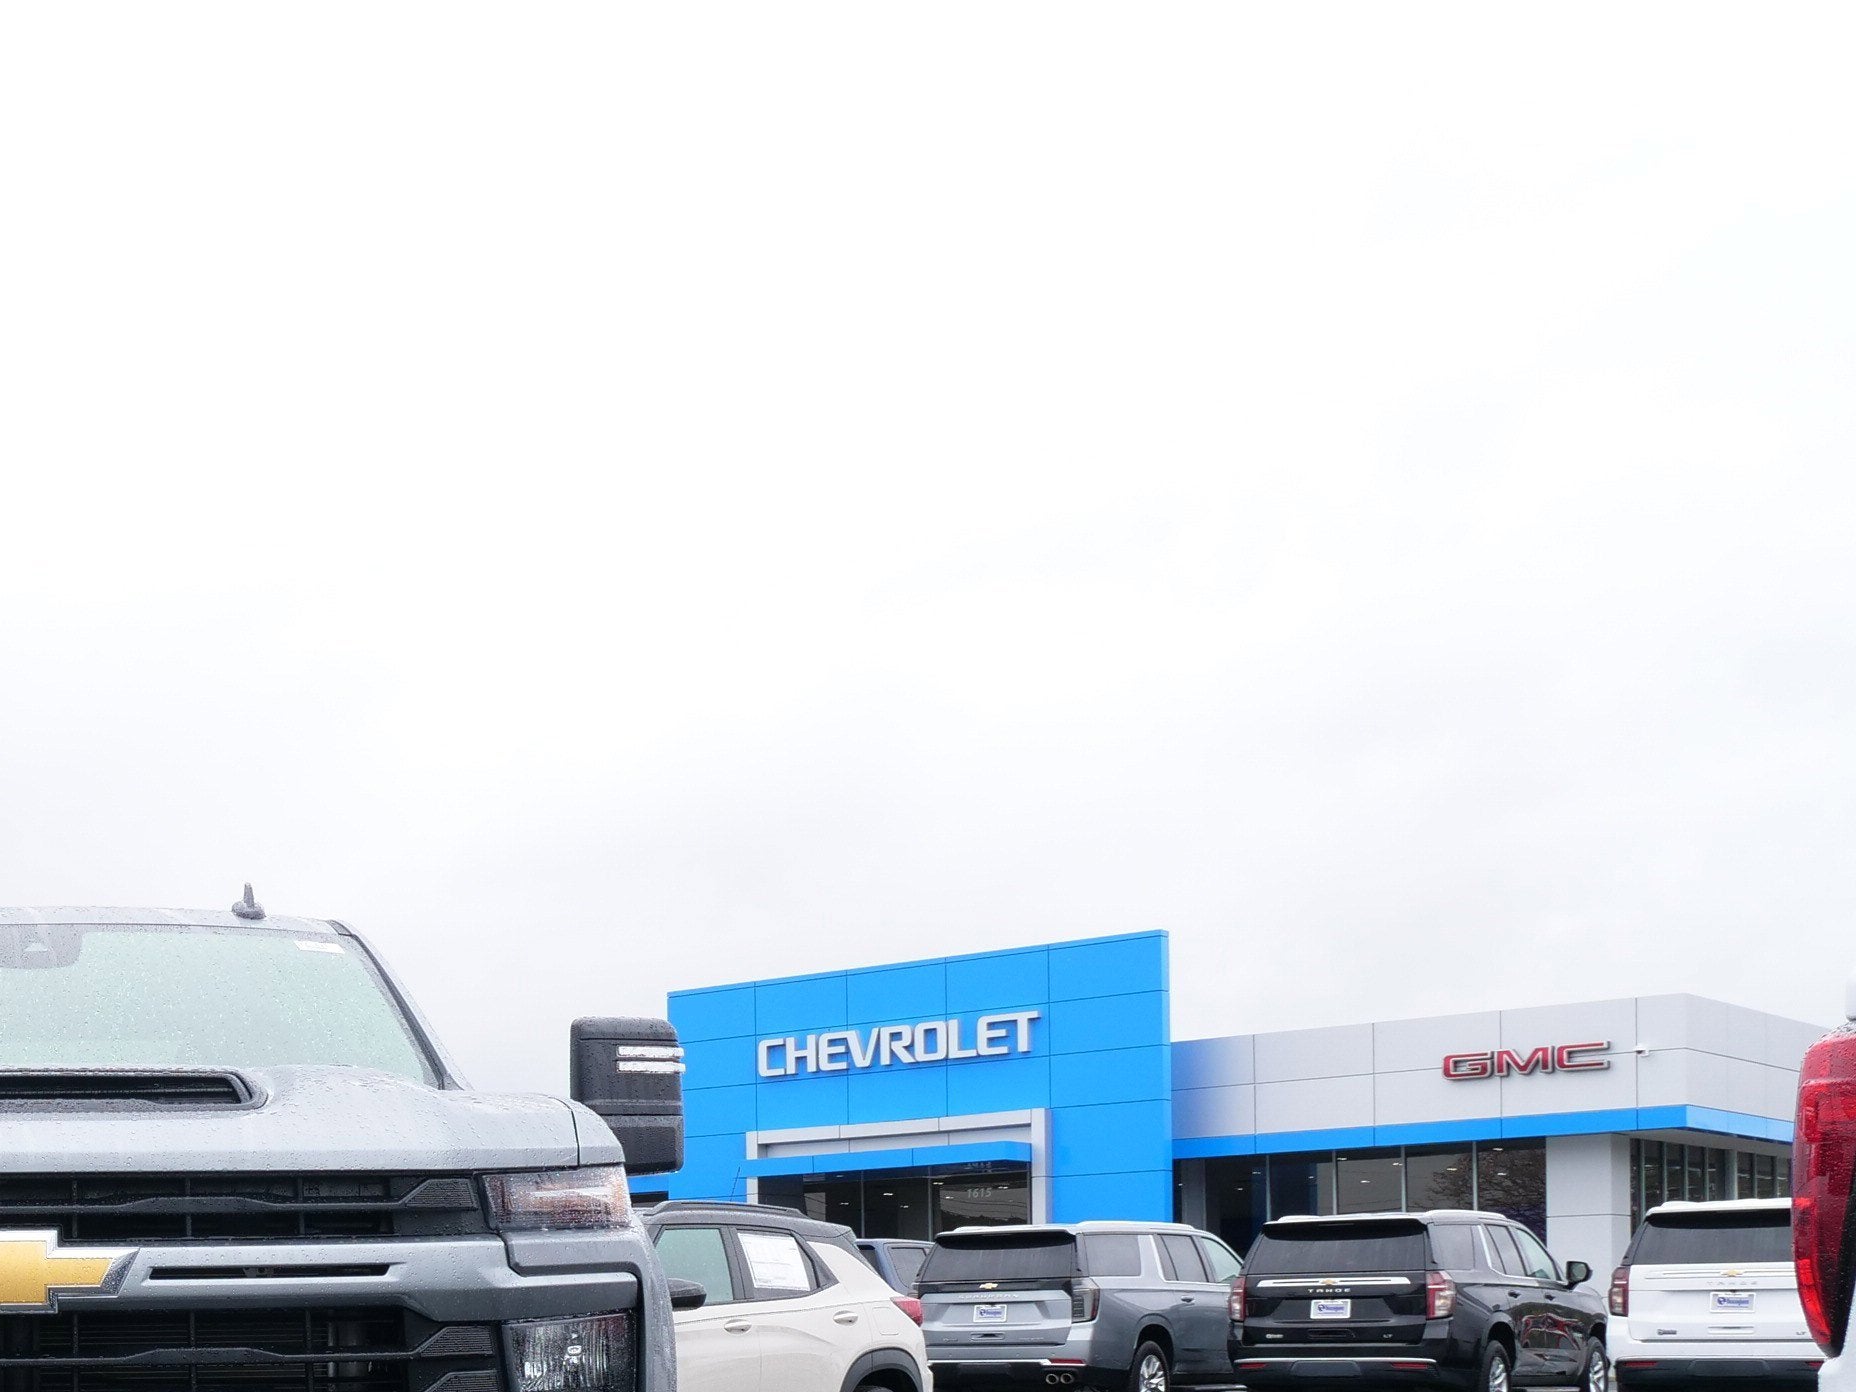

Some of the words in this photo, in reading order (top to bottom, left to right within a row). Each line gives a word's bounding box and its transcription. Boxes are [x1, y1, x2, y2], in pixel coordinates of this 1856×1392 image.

[758, 1010, 1041, 1077] CHEVROLET
[1442, 1040, 1611, 1080] GMC
[967, 1188, 992, 1198] 1615
